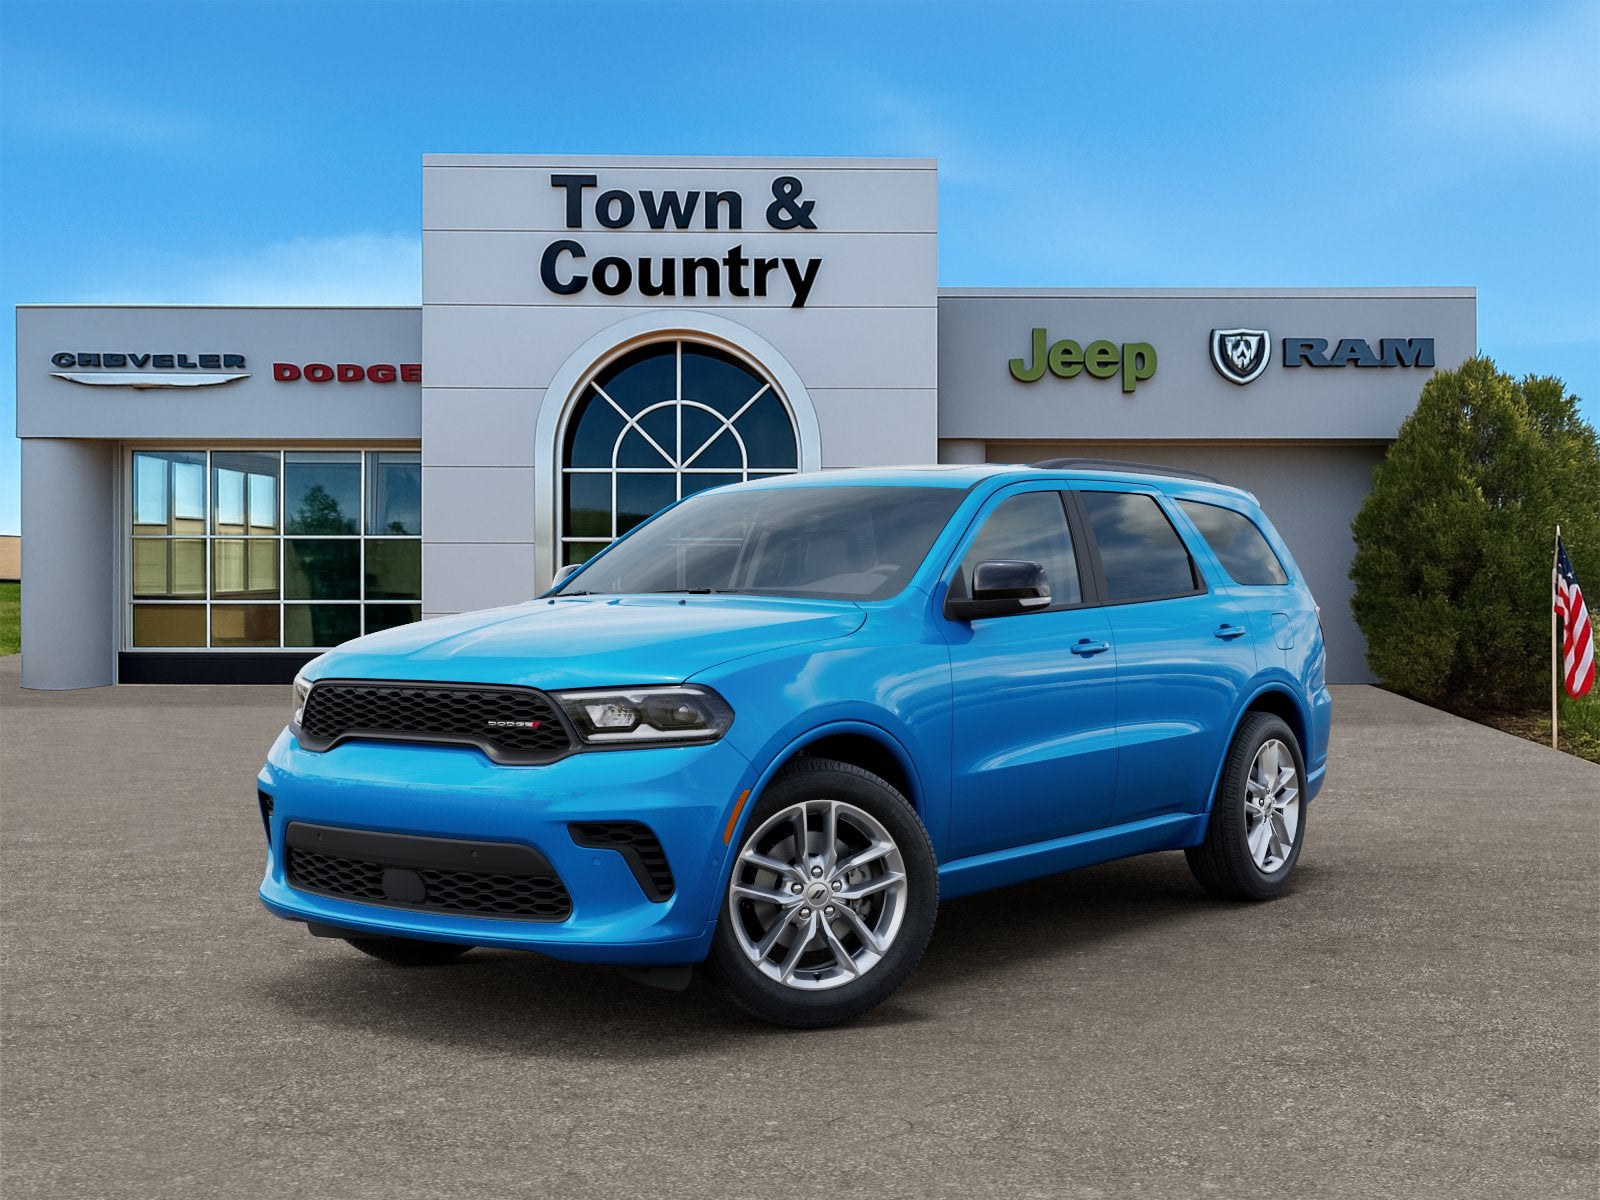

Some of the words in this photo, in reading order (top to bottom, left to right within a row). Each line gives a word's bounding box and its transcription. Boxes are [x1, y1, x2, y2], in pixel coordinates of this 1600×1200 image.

[550, 174, 742, 229] Town
[765, 175, 818, 230] &
[540, 239, 822, 308] Country
[273, 362, 422, 383] DODGE
[1009, 328, 1157, 392] Jeep
[1282, 337, 1436, 367] RAM
[487, 720, 534, 728] DODGE
